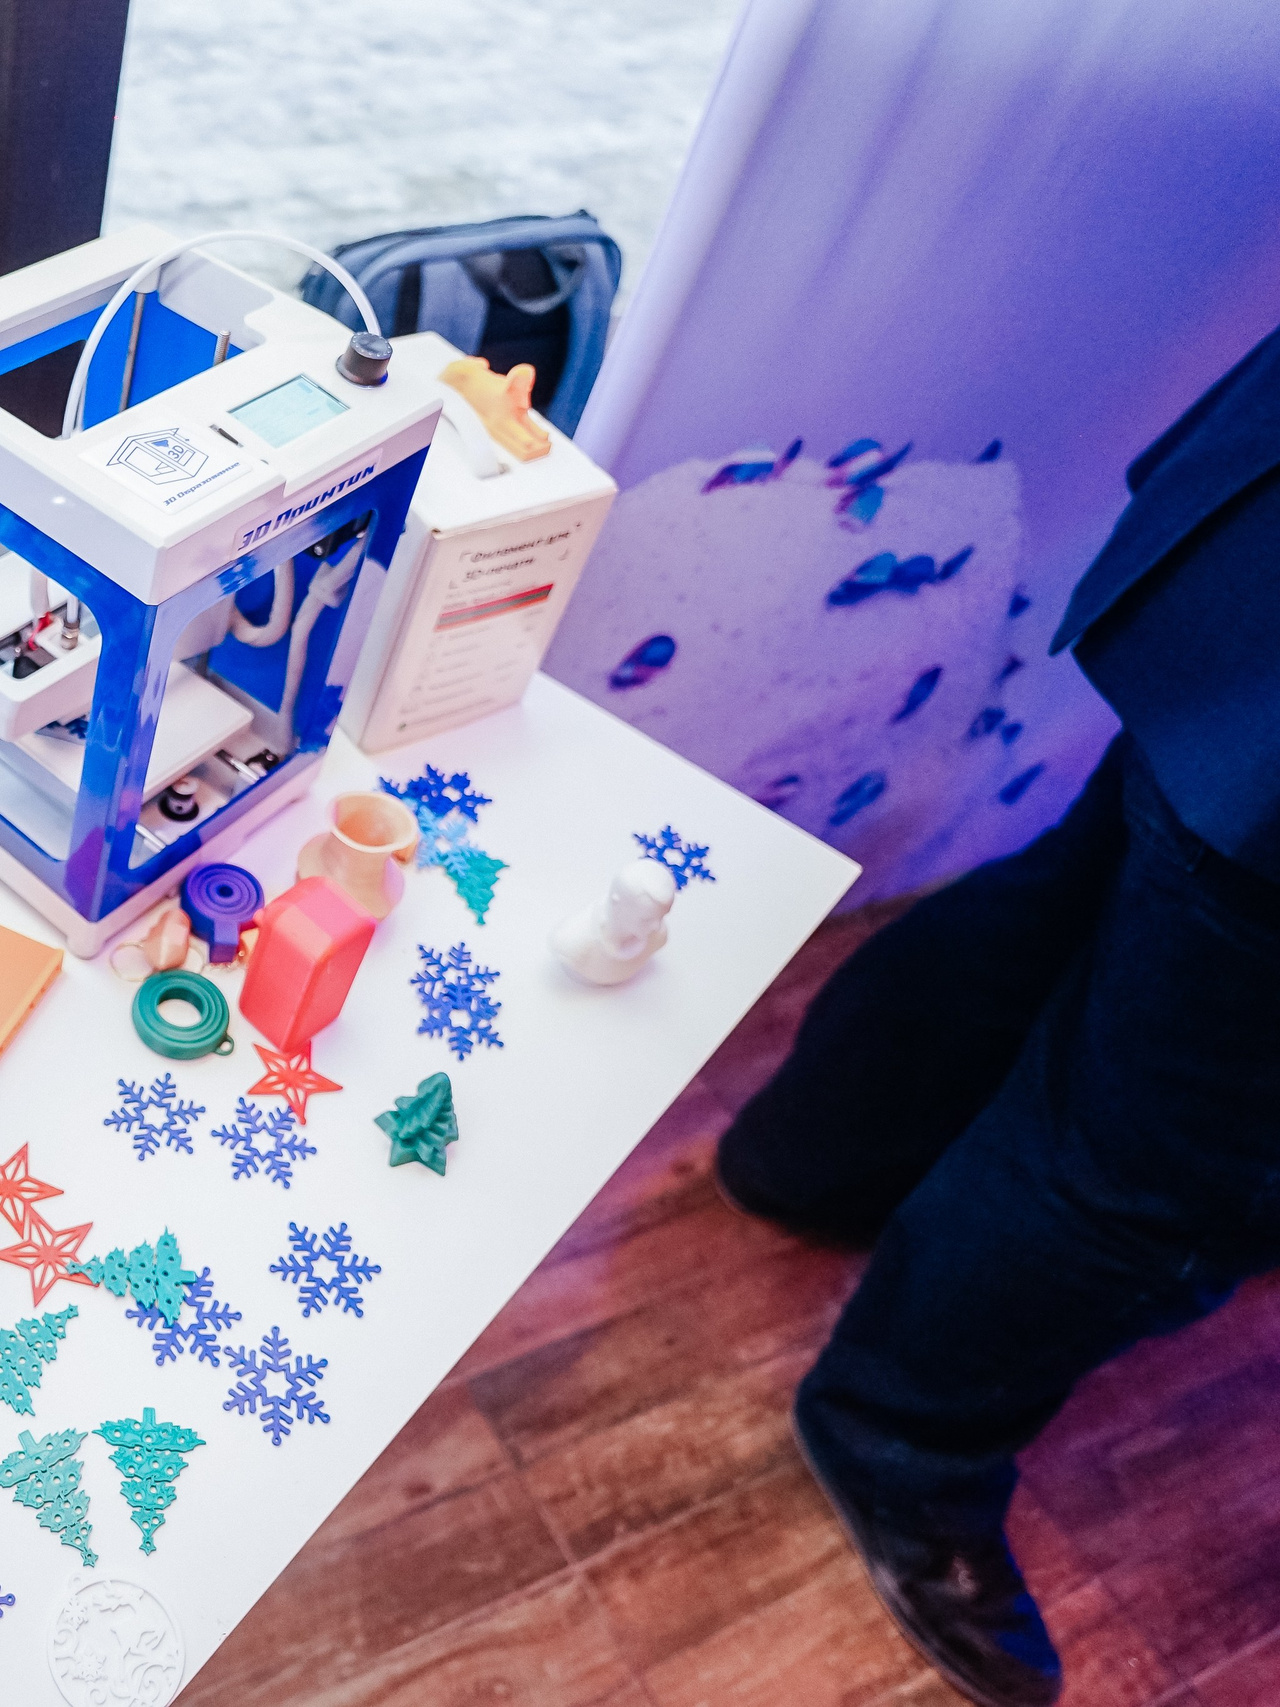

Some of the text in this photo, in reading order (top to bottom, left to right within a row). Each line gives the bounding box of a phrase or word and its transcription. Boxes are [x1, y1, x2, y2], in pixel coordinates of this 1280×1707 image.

[168, 444, 185, 459] 3D
[237, 463, 377, 551] 3D Принтик
